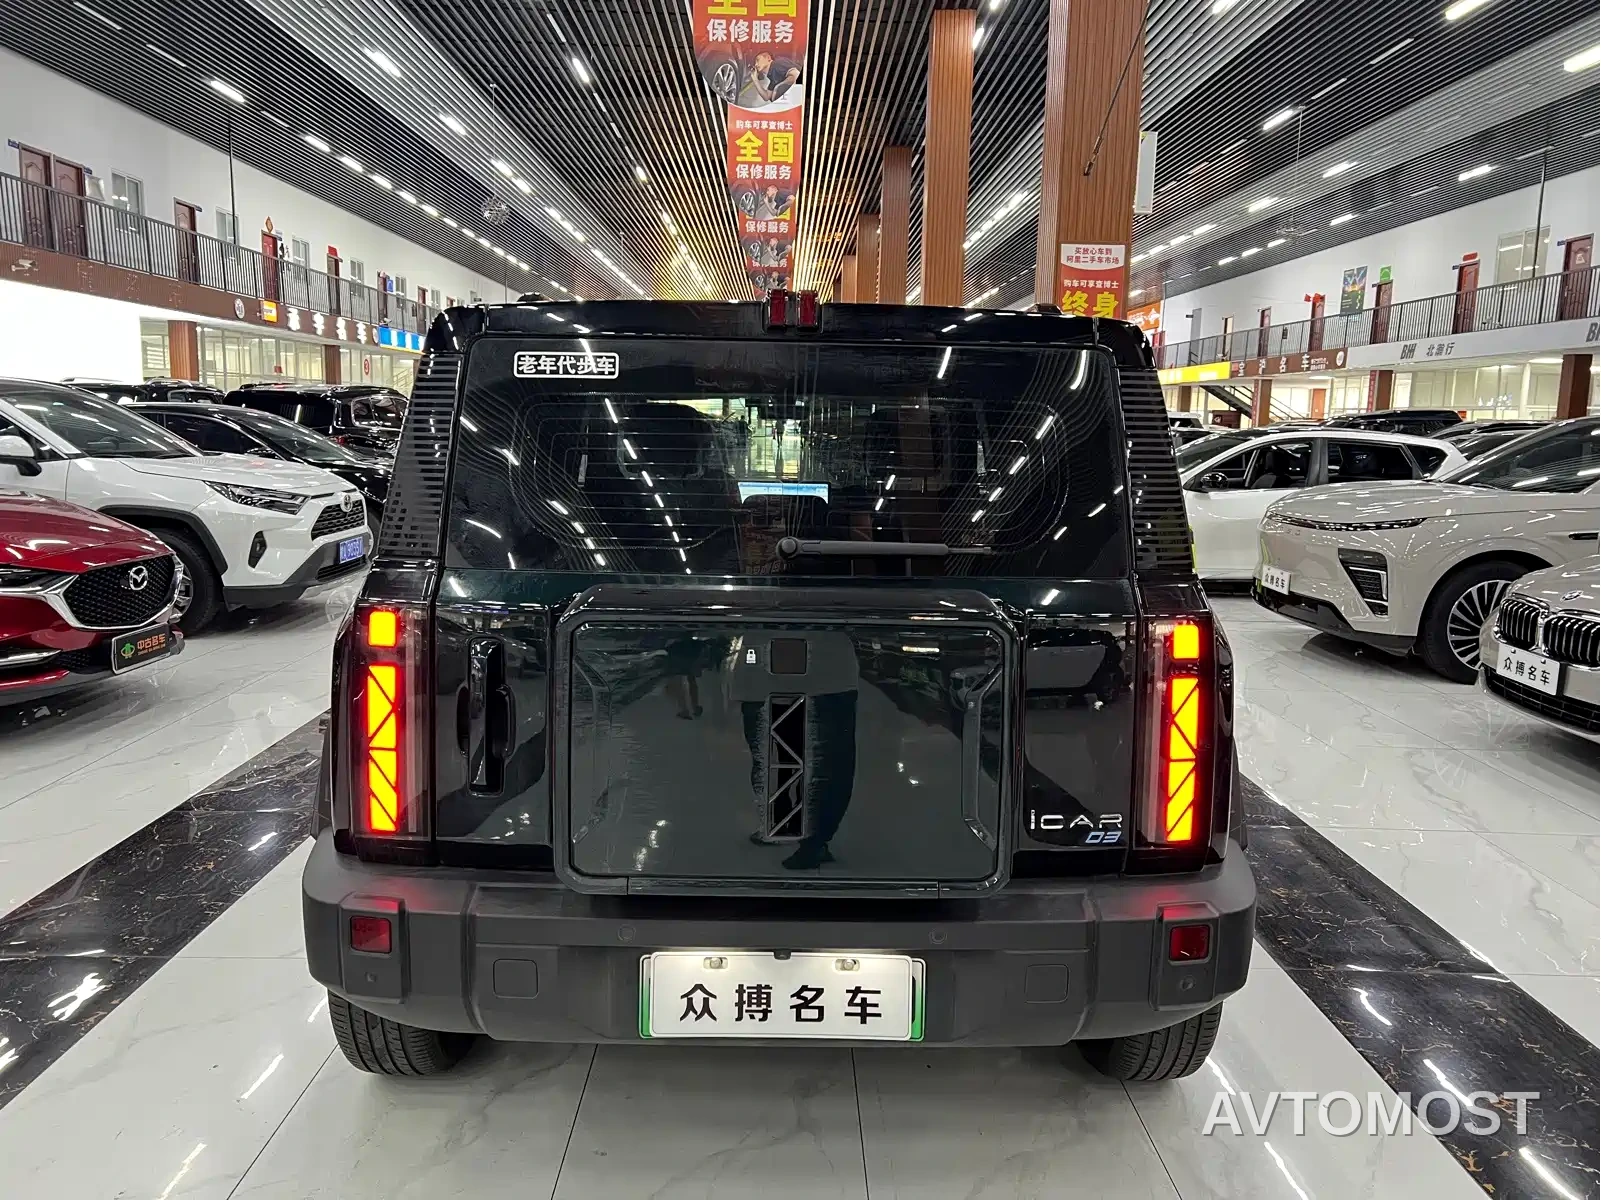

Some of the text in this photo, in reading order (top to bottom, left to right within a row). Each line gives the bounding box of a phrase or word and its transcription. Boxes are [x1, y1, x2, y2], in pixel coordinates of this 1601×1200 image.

[706, 18, 794, 43] 保修服务
[735, 120, 793, 130] 购车可享查博士
[734, 130, 794, 164] 全国
[735, 164, 792, 180] 保修服务
[745, 221, 789, 234] 保修服务
[1066, 255, 1120, 264] 阿里二手车市场
[1074, 247, 1113, 256] 买放心车到
[1063, 279, 1120, 289] 购车可享查博士
[1061, 290, 1119, 318] 终身
[518, 355, 615, 375] 老年代步车
[679, 983, 882, 1025] 众搏名车
